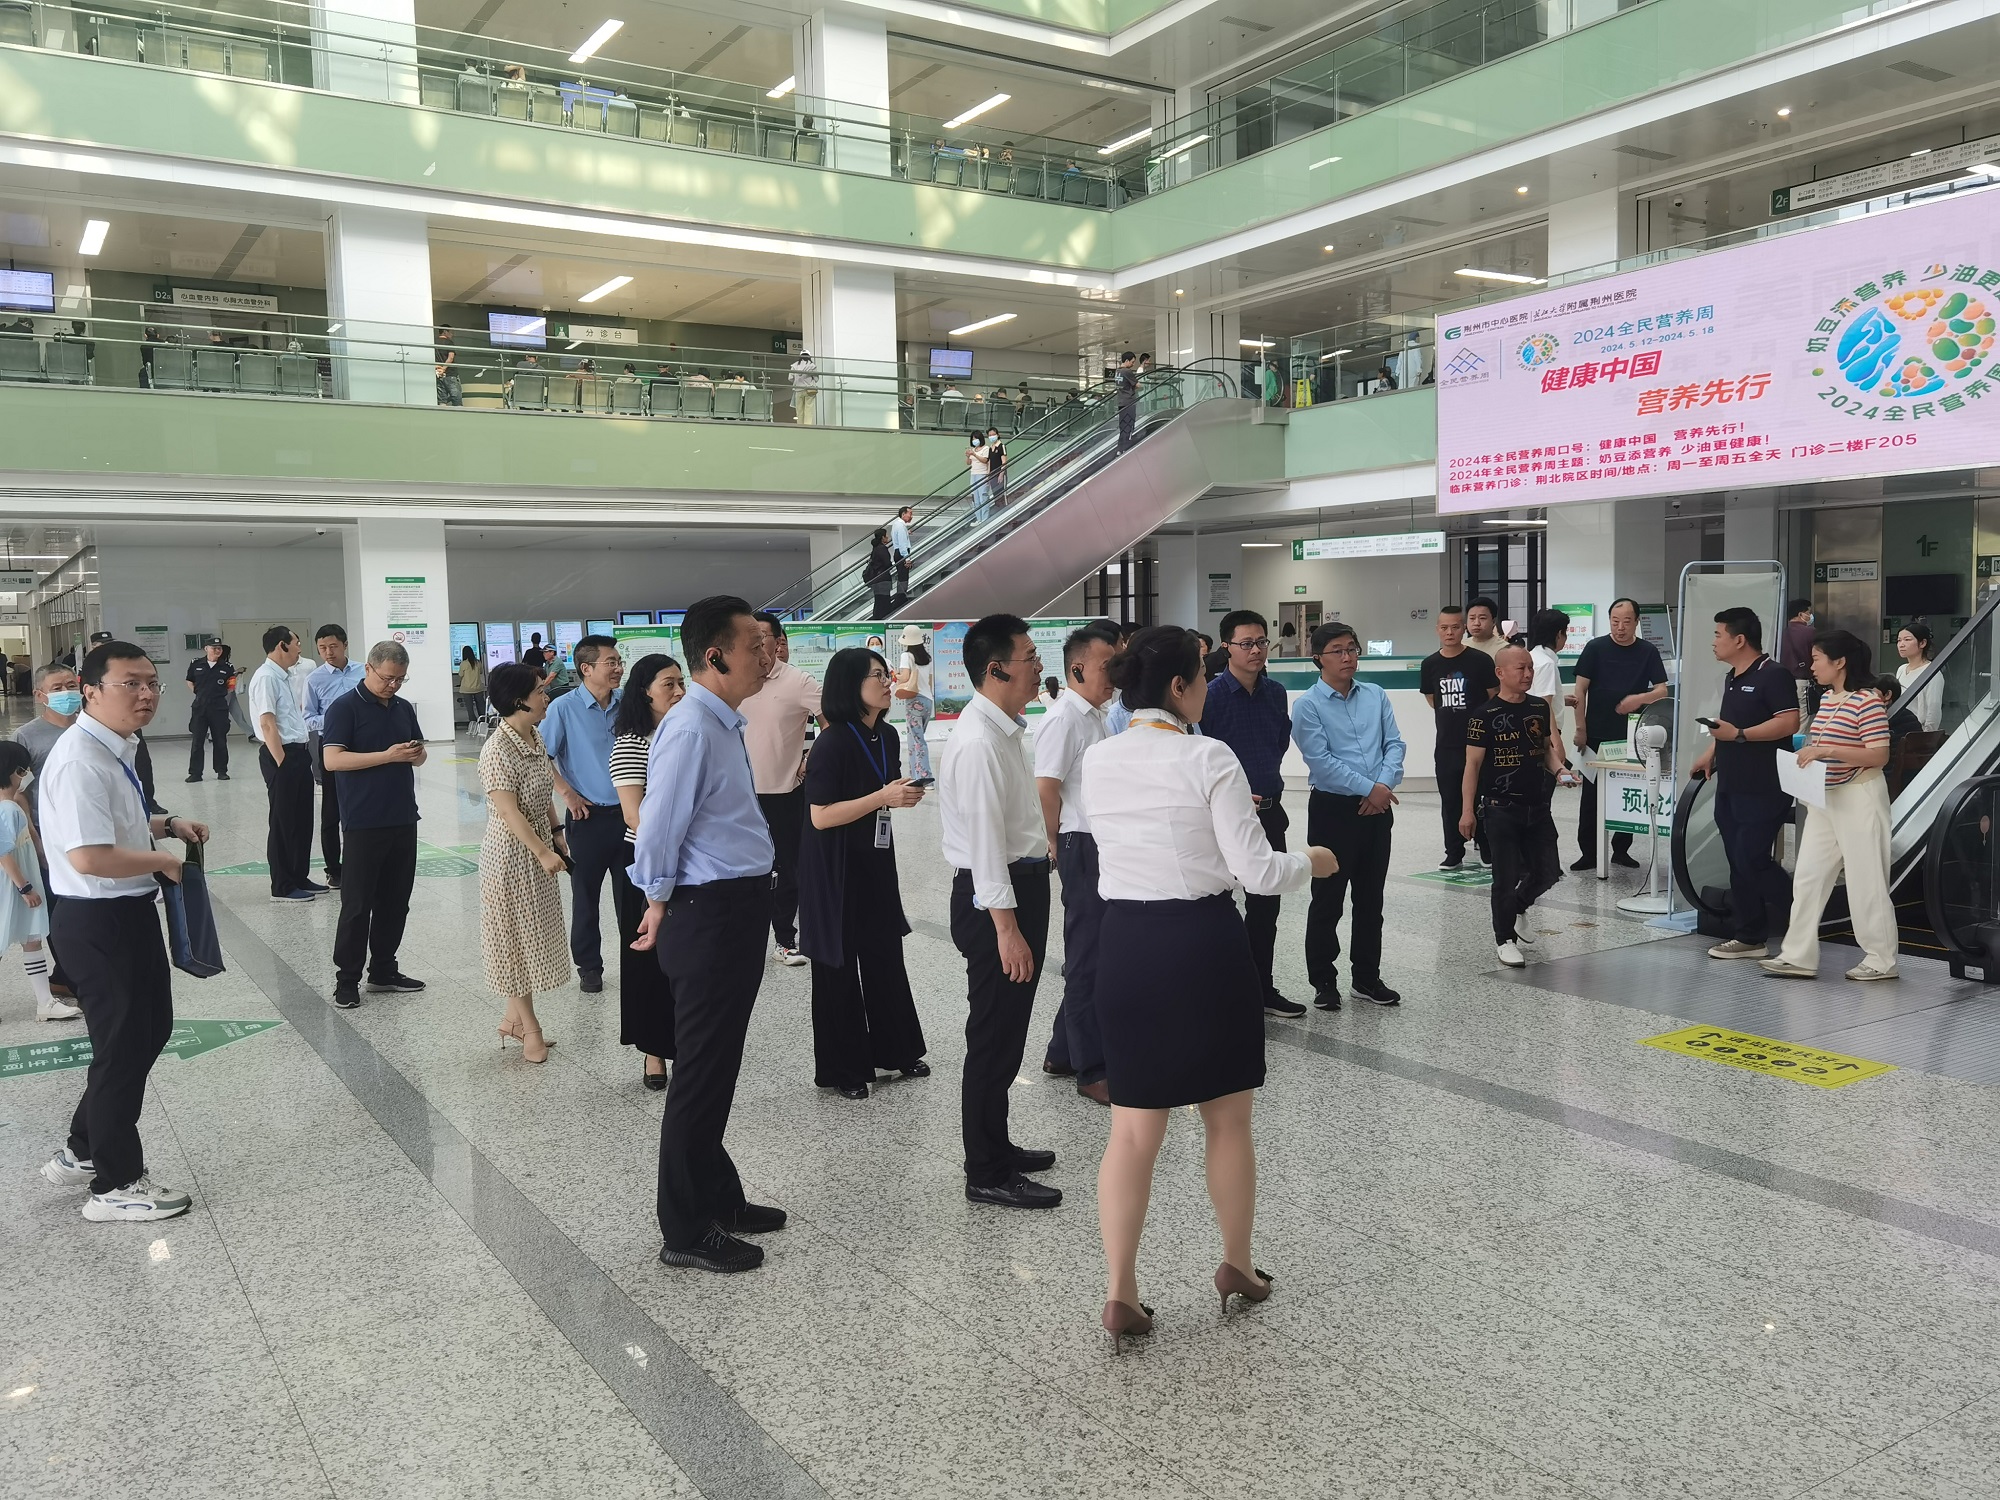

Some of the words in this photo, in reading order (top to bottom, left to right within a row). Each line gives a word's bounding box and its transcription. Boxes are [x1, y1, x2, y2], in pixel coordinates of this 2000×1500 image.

[1775, 194, 1790, 209] 2F
[1920, 263, 2000, 303] 少油更
[586, 328, 622, 339] 分诊台
[1464, 312, 1528, 333] 荆州市中心医院
[1573, 304, 1714, 346] 2024全民营养周
[1541, 349, 1663, 394] 健康中国
[1636, 372, 1772, 416] 营养先行
[1792, 434, 1918, 458] 门诊二楼F205
[1916, 534, 1939, 557] 1F
[1440, 678, 1464, 694] STAY
[1442, 693, 1466, 708] NICE
